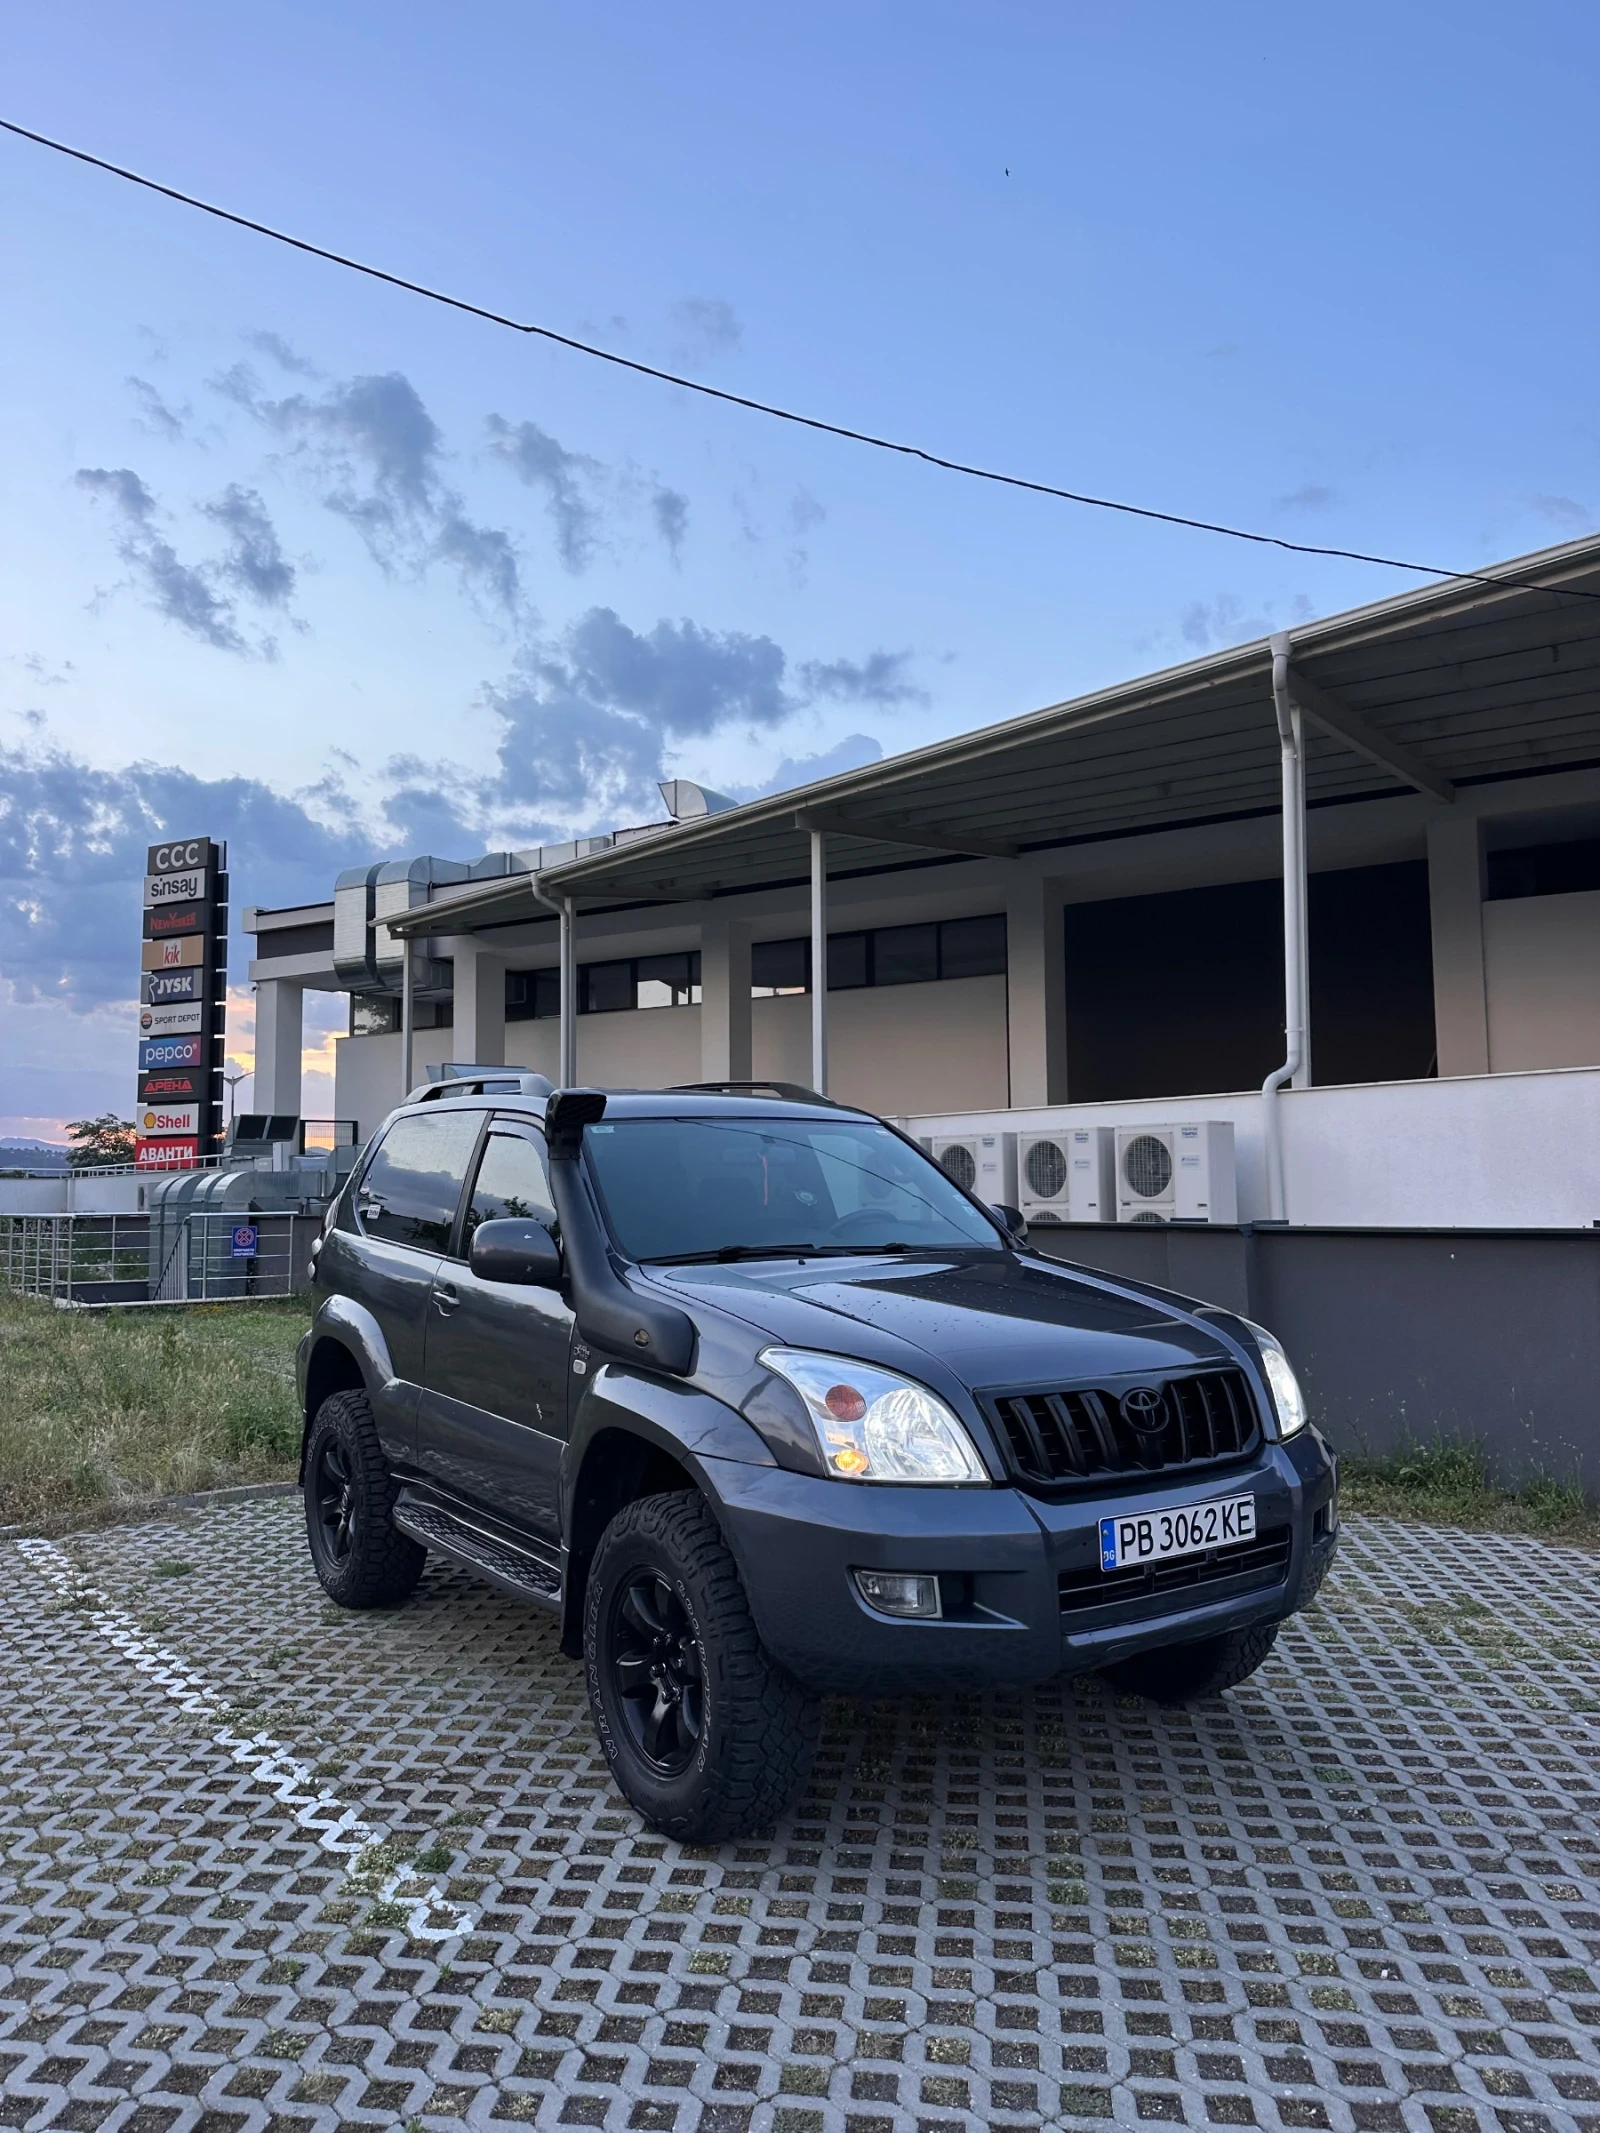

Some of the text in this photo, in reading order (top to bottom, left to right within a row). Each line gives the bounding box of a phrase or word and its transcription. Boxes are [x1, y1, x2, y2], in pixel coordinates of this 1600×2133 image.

[156, 843, 199, 869] CCC
[151, 877, 197, 897] sinsay
[157, 976, 192, 995] JYSK
[154, 1015, 177, 1025] SPORT
[177, 1013, 200, 1023] DEPOT
[144, 1080, 193, 1093] АРЕНА
[156, 1114, 190, 1129] Shell
[139, 1146, 193, 1161] АВАНТИ
[588, 1581, 619, 1760] WRANGLER
[676, 1579, 711, 1773] GOODYEAR
